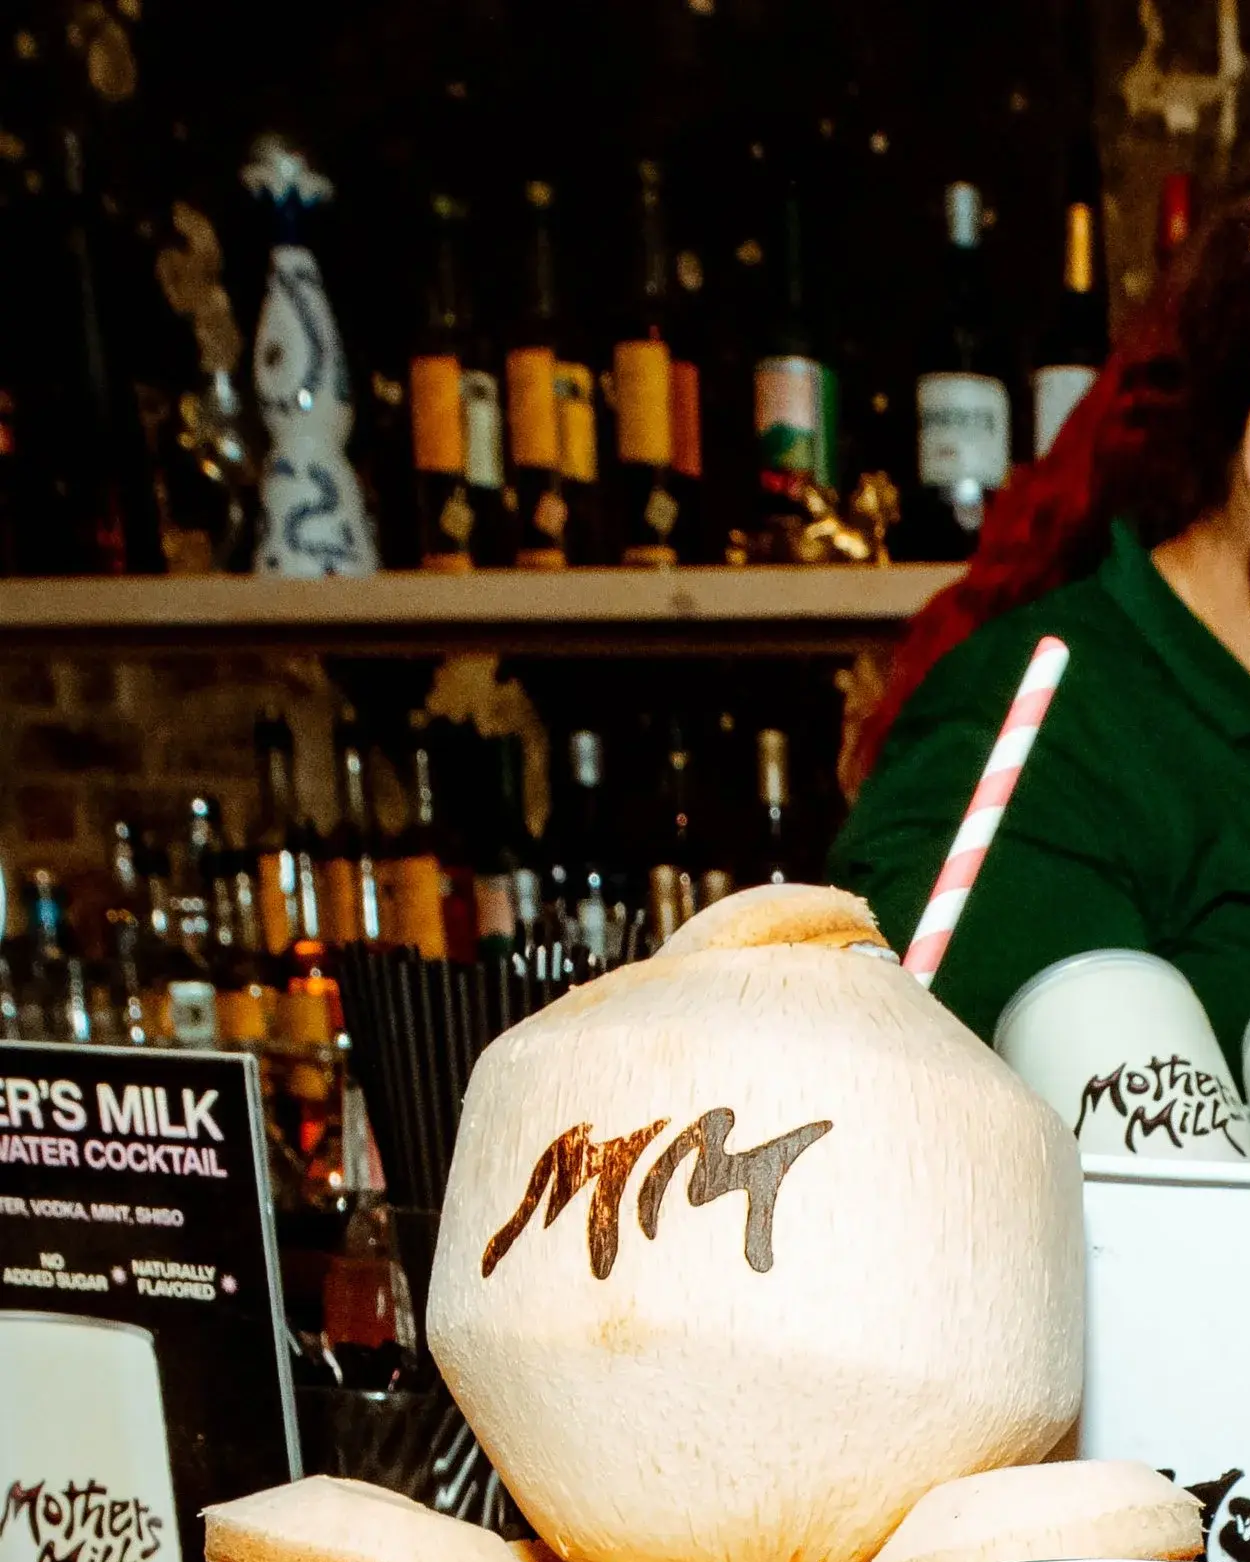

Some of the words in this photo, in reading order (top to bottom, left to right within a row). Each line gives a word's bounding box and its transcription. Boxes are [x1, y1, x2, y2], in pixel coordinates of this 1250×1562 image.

[97, 1083, 224, 1141] MILK
[1125, 1098, 1247, 1158] Milk
[84, 1139, 228, 1178] COCKTAIL
[482, 1106, 832, 1280] MM
[3, 1267, 55, 1288] ADDED
[56, 1271, 109, 1292] SUGAR
[40, 1252, 65, 1270] NO
[132, 1259, 216, 1282] NATURALLY
[137, 1278, 216, 1301] FLAVORED
[0, 1479, 163, 1560] Mothers
